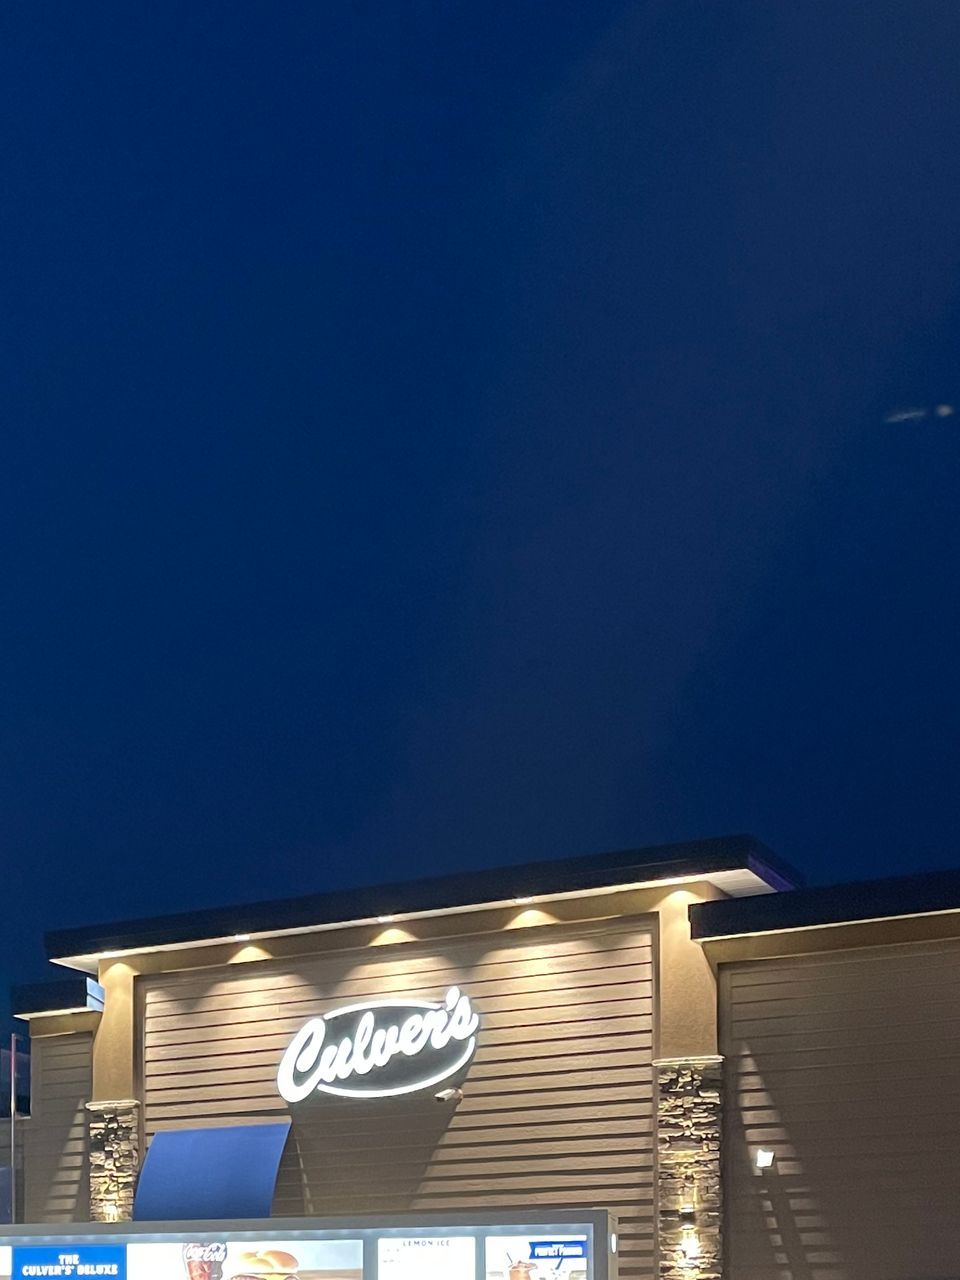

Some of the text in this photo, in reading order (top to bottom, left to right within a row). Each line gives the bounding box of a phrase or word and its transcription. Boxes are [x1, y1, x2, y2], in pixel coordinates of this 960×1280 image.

[277, 986, 479, 1103] Culver's
[58, 1254, 79, 1264] THE
[77, 1264, 118, 1275] DELUXE
